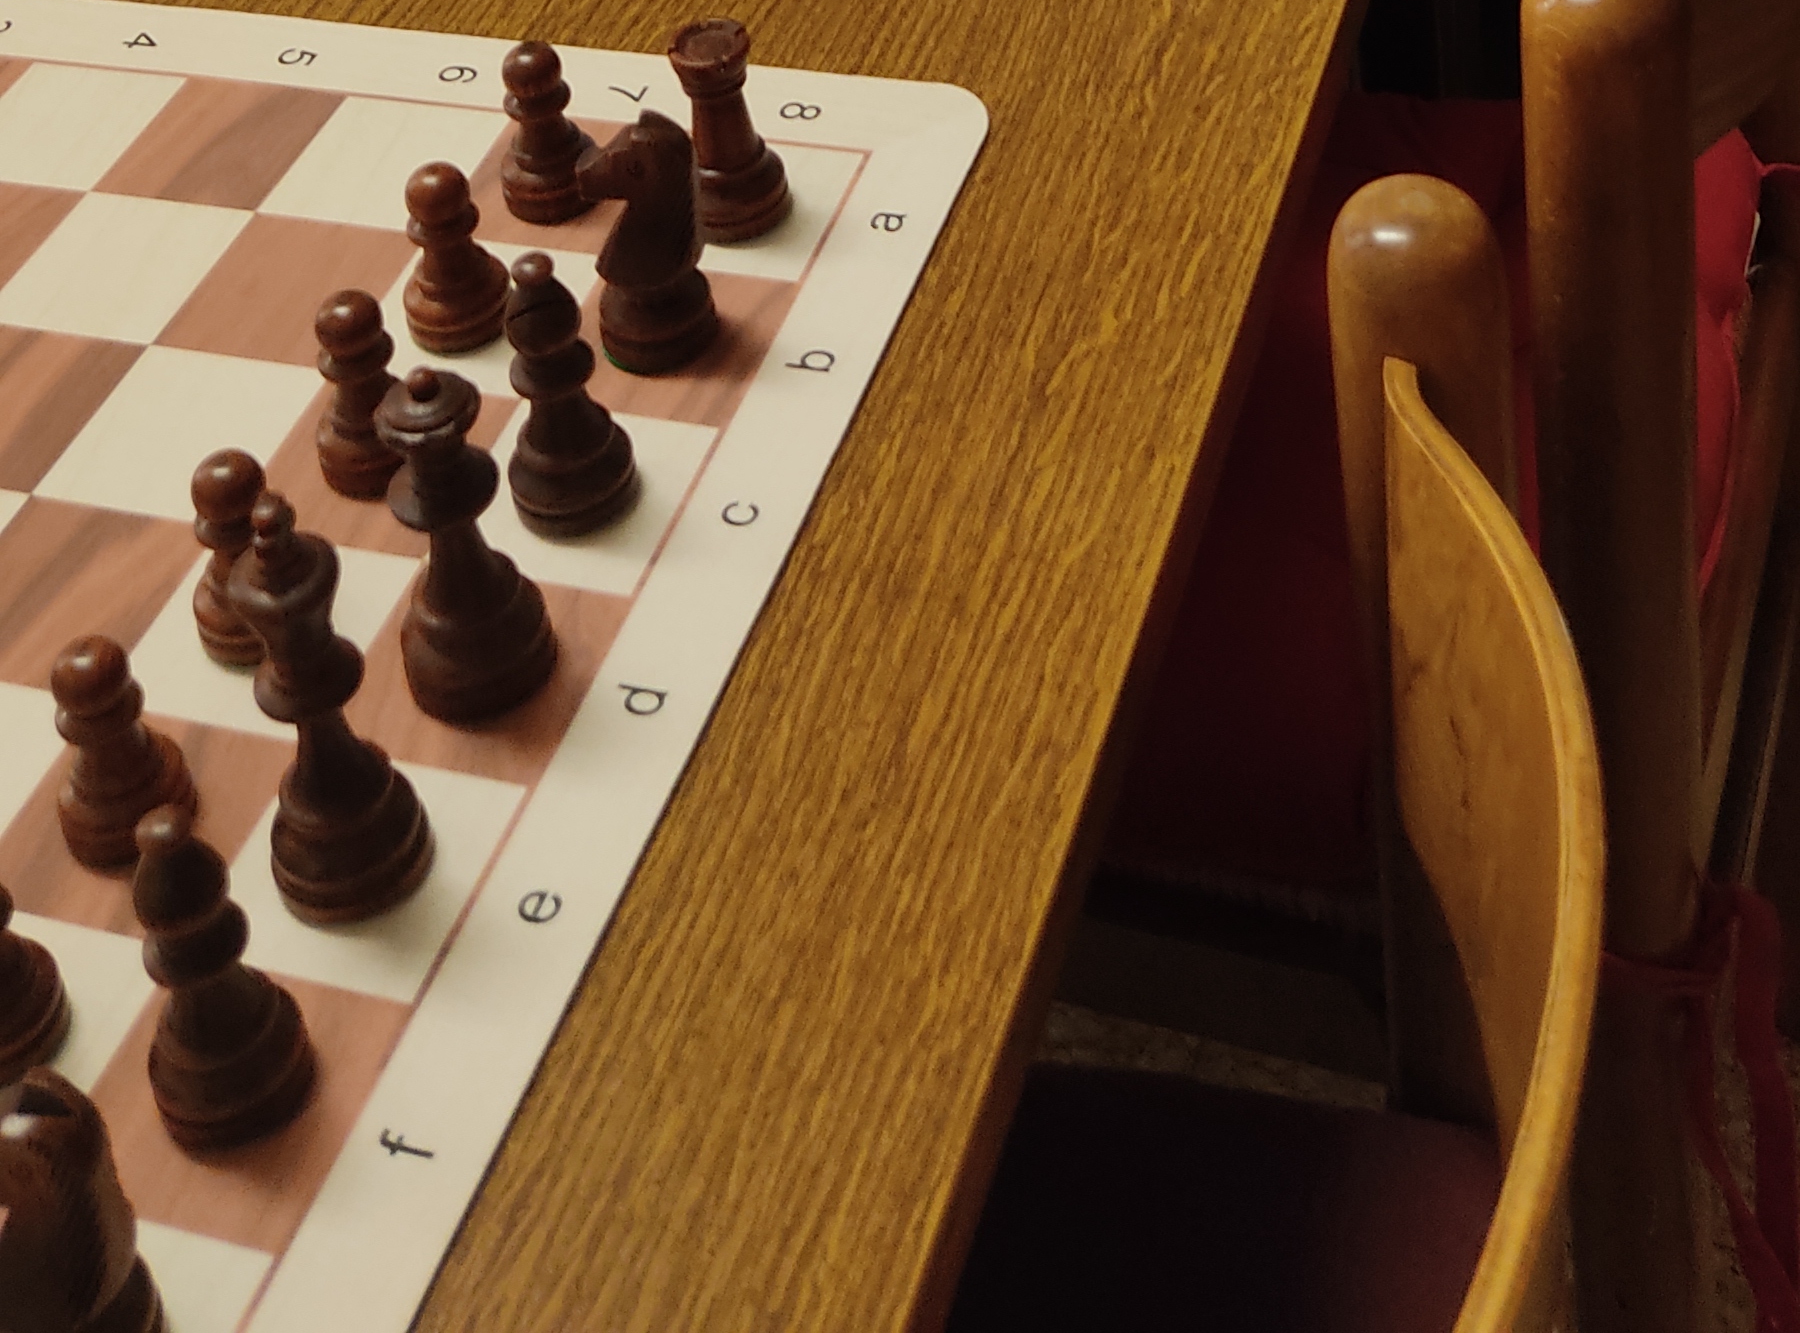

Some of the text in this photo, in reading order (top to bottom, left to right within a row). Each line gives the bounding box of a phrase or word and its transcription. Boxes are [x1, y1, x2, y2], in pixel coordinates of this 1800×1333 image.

[123, 32, 157, 49] 4
[277, 47, 318, 67] 5
[438, 64, 478, 84] 6
[608, 85, 649, 103] 7
[780, 102, 821, 120] 8
[871, 211, 907, 233] a
[785, 349, 835, 373] b
[720, 500, 760, 528] c
[619, 681, 668, 716] d
[517, 888, 562, 925] e
[378, 1127, 435, 1160] f
